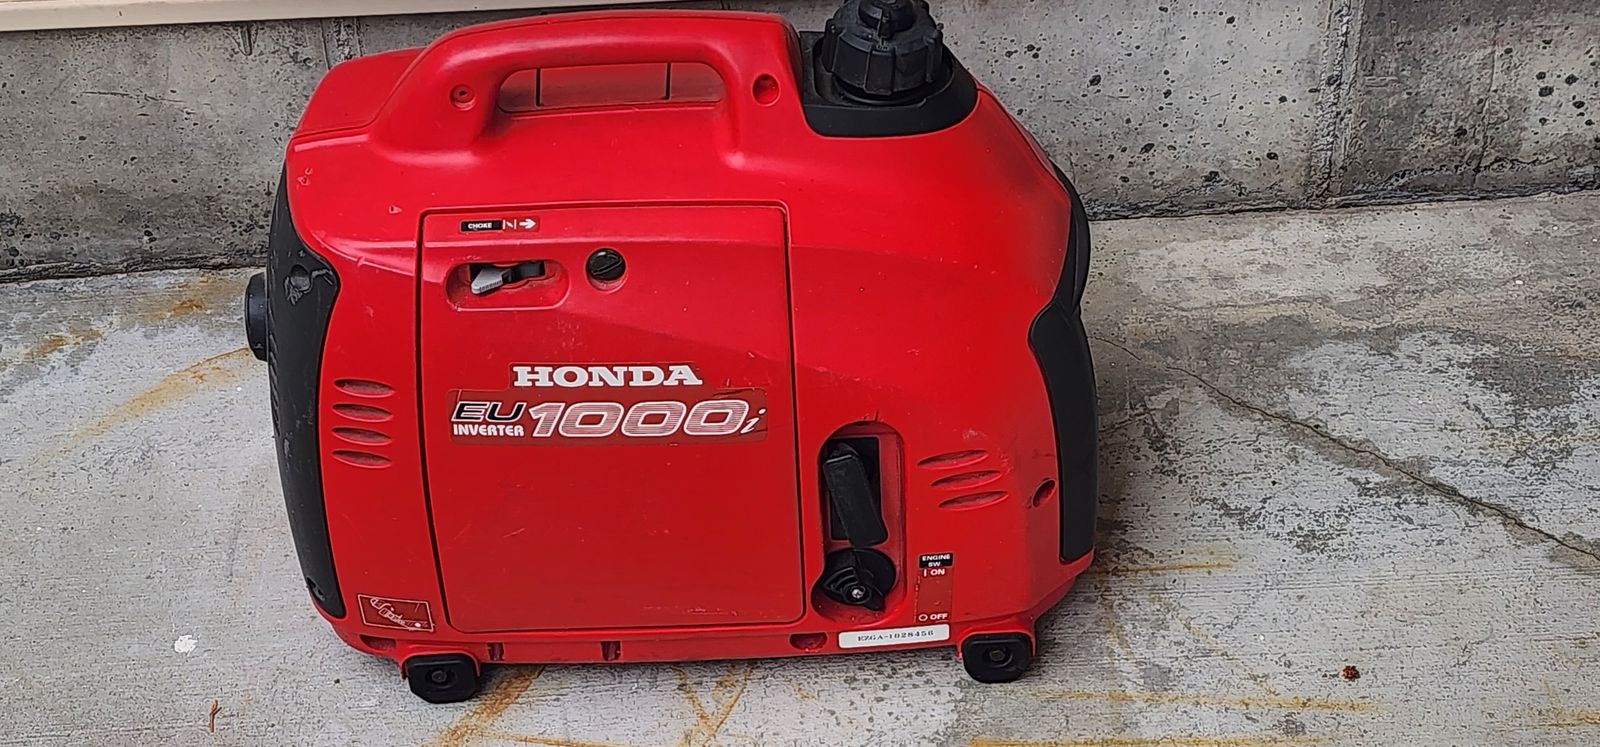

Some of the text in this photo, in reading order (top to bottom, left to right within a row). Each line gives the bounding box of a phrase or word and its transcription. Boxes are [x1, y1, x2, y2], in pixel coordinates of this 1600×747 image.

[512, 364, 703, 388] HONDA
[451, 400, 768, 438] EU 1000i
[453, 423, 525, 437] INVERTER
[930, 568, 945, 576] ON
[930, 612, 948, 620] OFF
